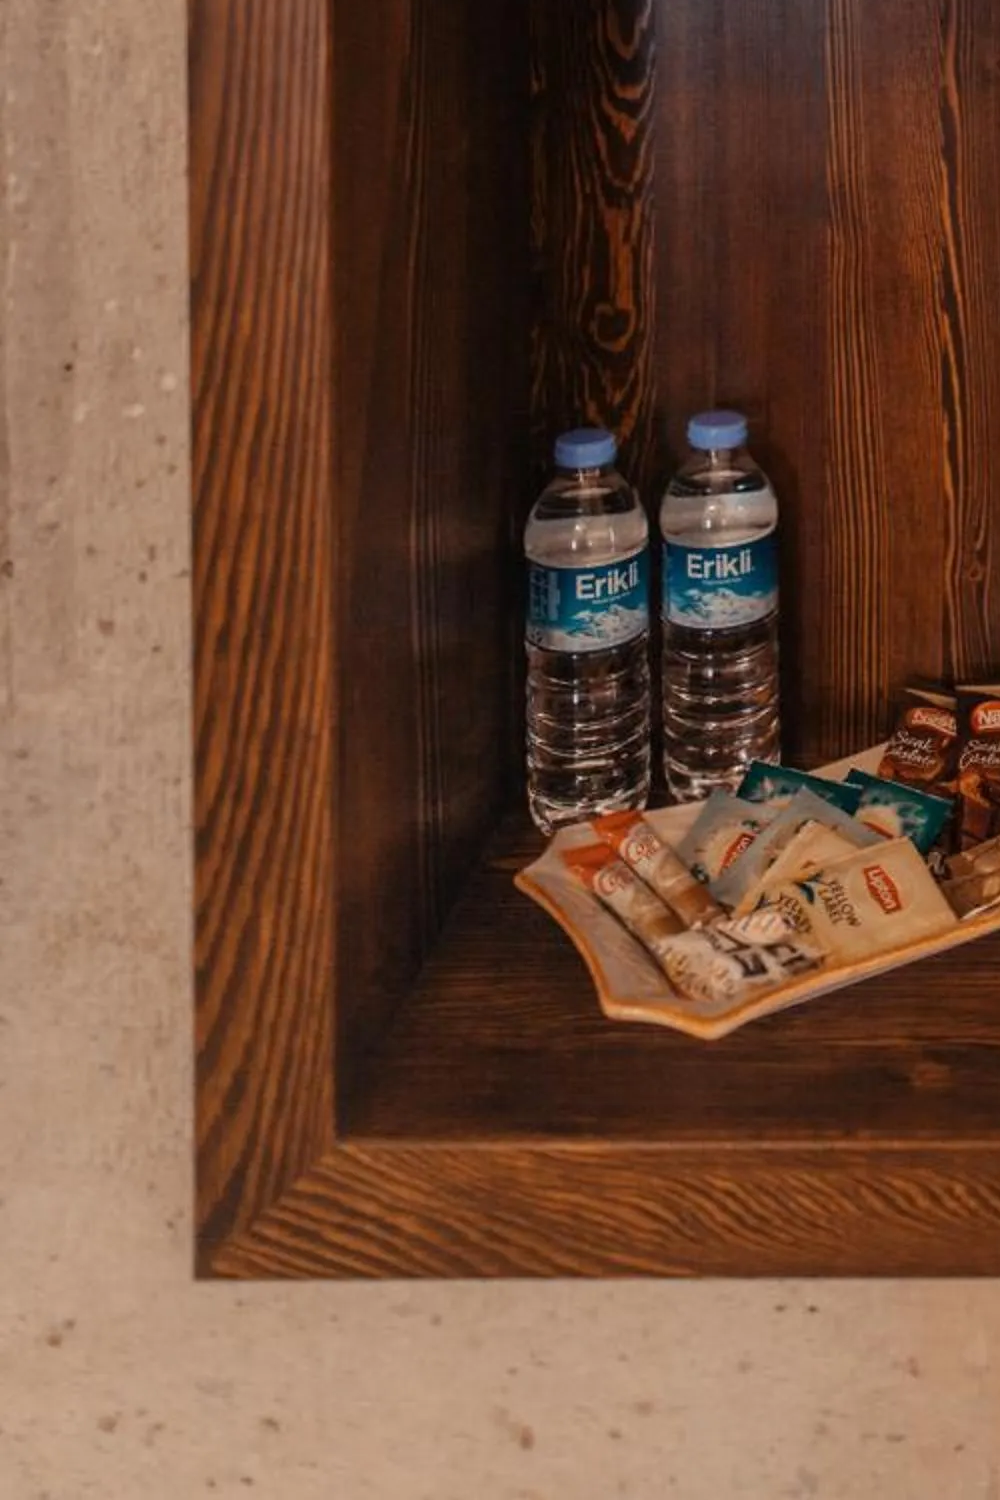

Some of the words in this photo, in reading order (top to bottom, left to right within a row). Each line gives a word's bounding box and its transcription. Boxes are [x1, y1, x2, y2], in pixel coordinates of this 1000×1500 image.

[575, 560, 639, 600] Erikli
[686, 548, 752, 579] Erikli
[823, 878, 862, 927] YELLOW
[867, 866, 899, 912] Lipton
